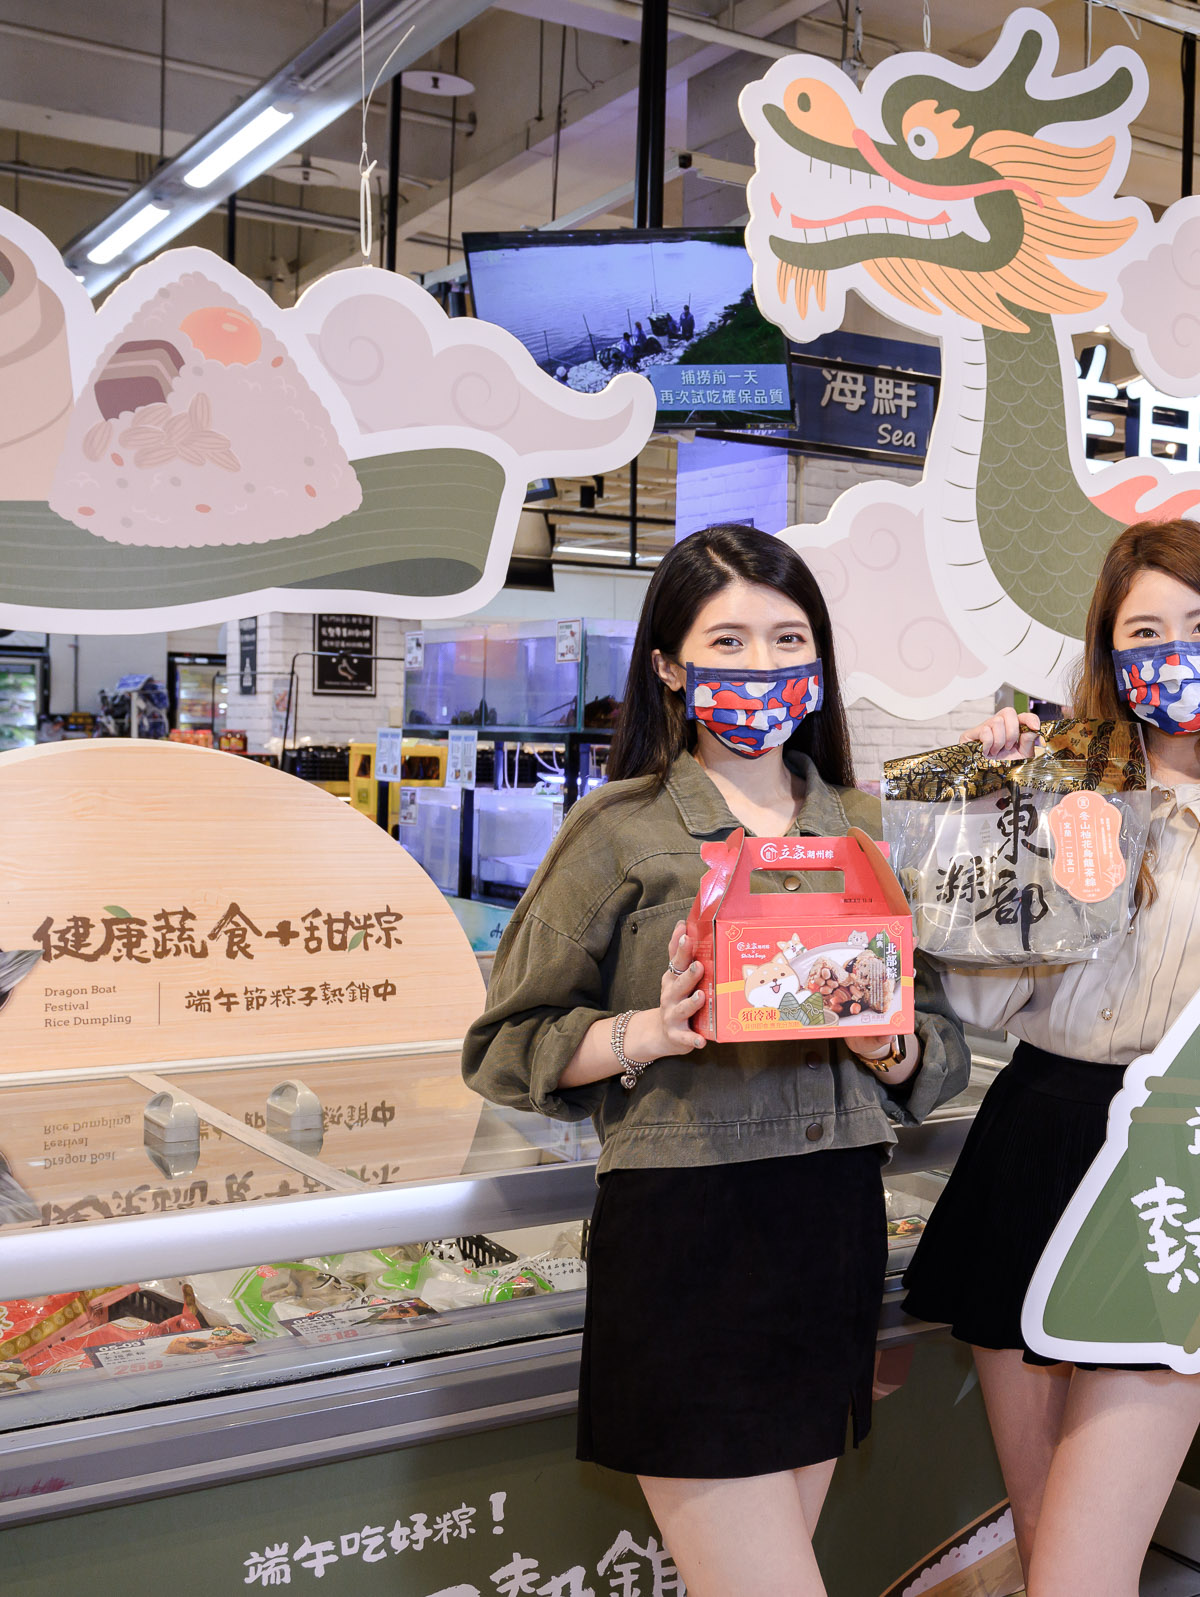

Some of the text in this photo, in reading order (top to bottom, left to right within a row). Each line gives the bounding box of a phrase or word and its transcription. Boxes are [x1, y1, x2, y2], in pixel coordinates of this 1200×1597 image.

[681, 369, 758, 386] 捕撈前一天
[660, 388, 784, 405] 再次試吃確保品質
[877, 424, 917, 449] Sea
[32, 901, 404, 964] 健康蔬食+甜粽
[885, 943, 898, 979] 北部粽
[44, 983, 117, 999] Dragon Boat
[185, 979, 397, 1014] 端午節粽子熱銷中
[44, 1000, 89, 1013] Festival
[44, 1013, 132, 1028] Rice Dumpling
[318, 1329, 359, 1343] 318
[113, 1359, 164, 1376] 258
